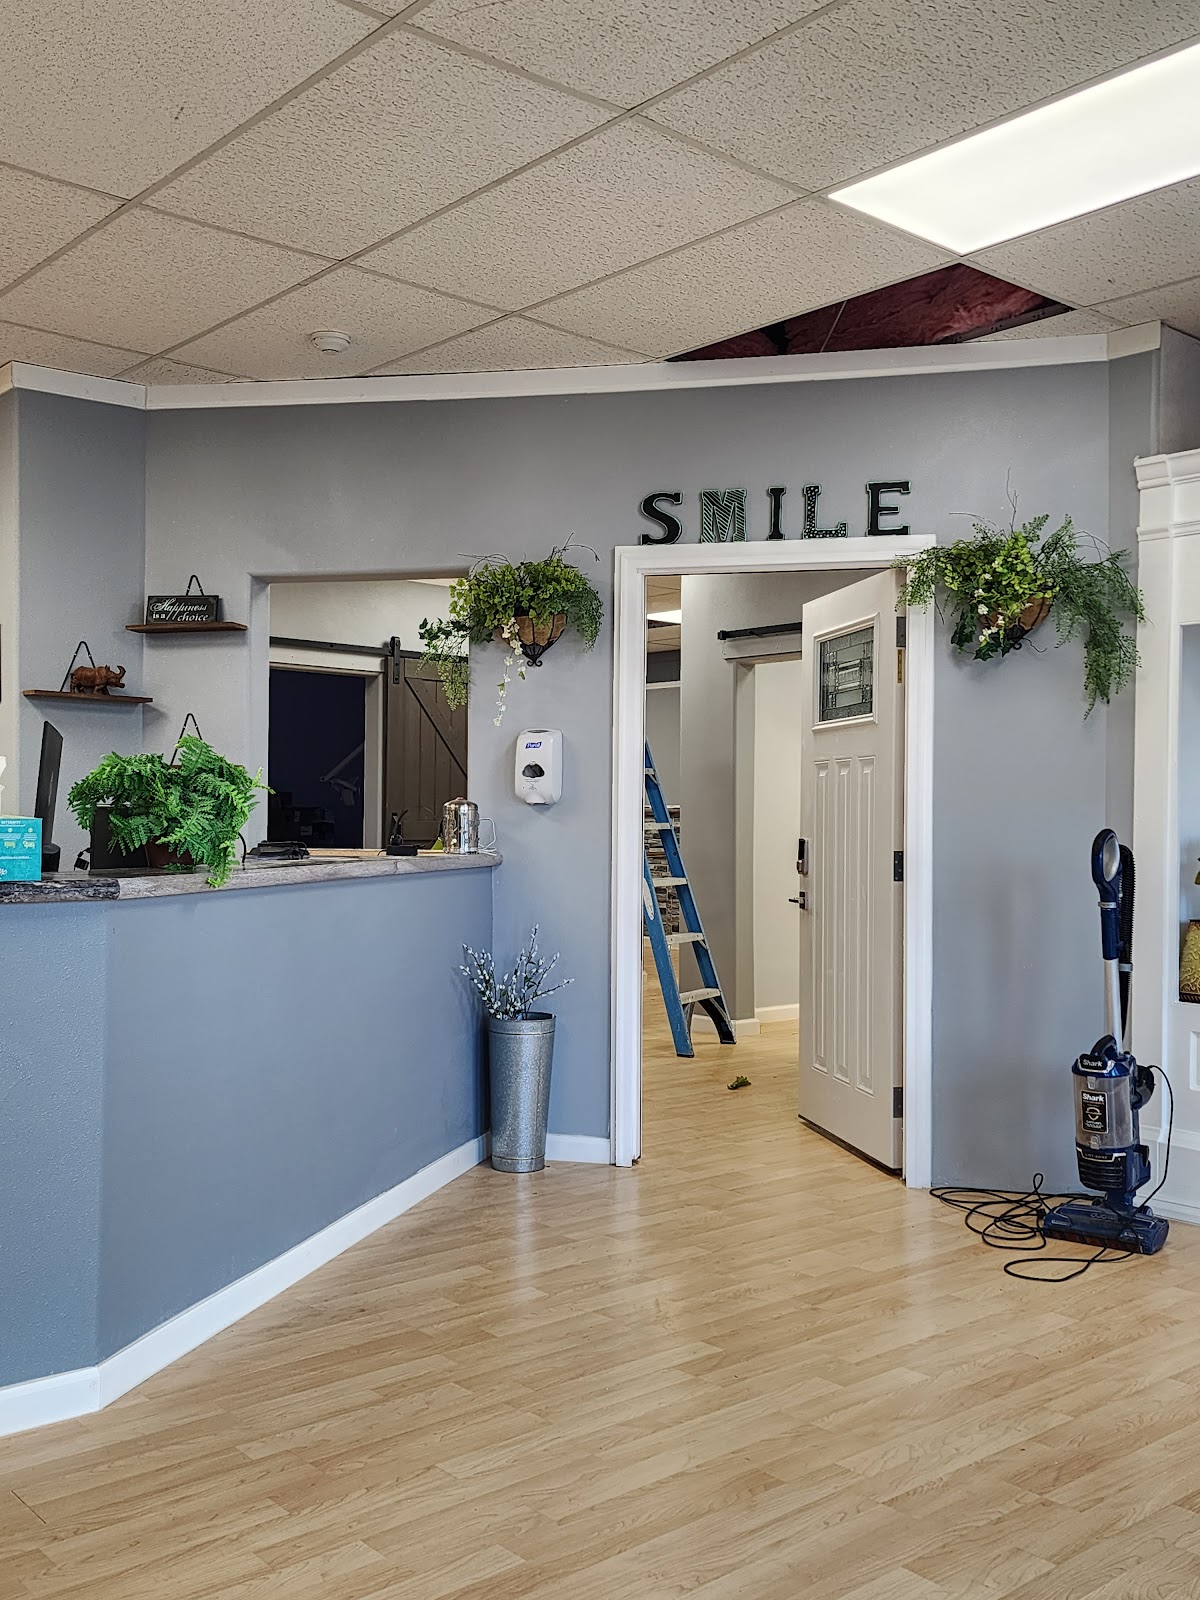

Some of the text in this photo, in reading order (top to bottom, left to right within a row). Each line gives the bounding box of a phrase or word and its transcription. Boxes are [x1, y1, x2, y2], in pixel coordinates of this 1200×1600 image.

[641, 481, 911, 545] SMILE
[150, 598, 207, 620] Happiness
[177, 612, 209, 622] choice
[1082, 1059, 1103, 1067] Shark
[1082, 1093, 1104, 1101] Shark
